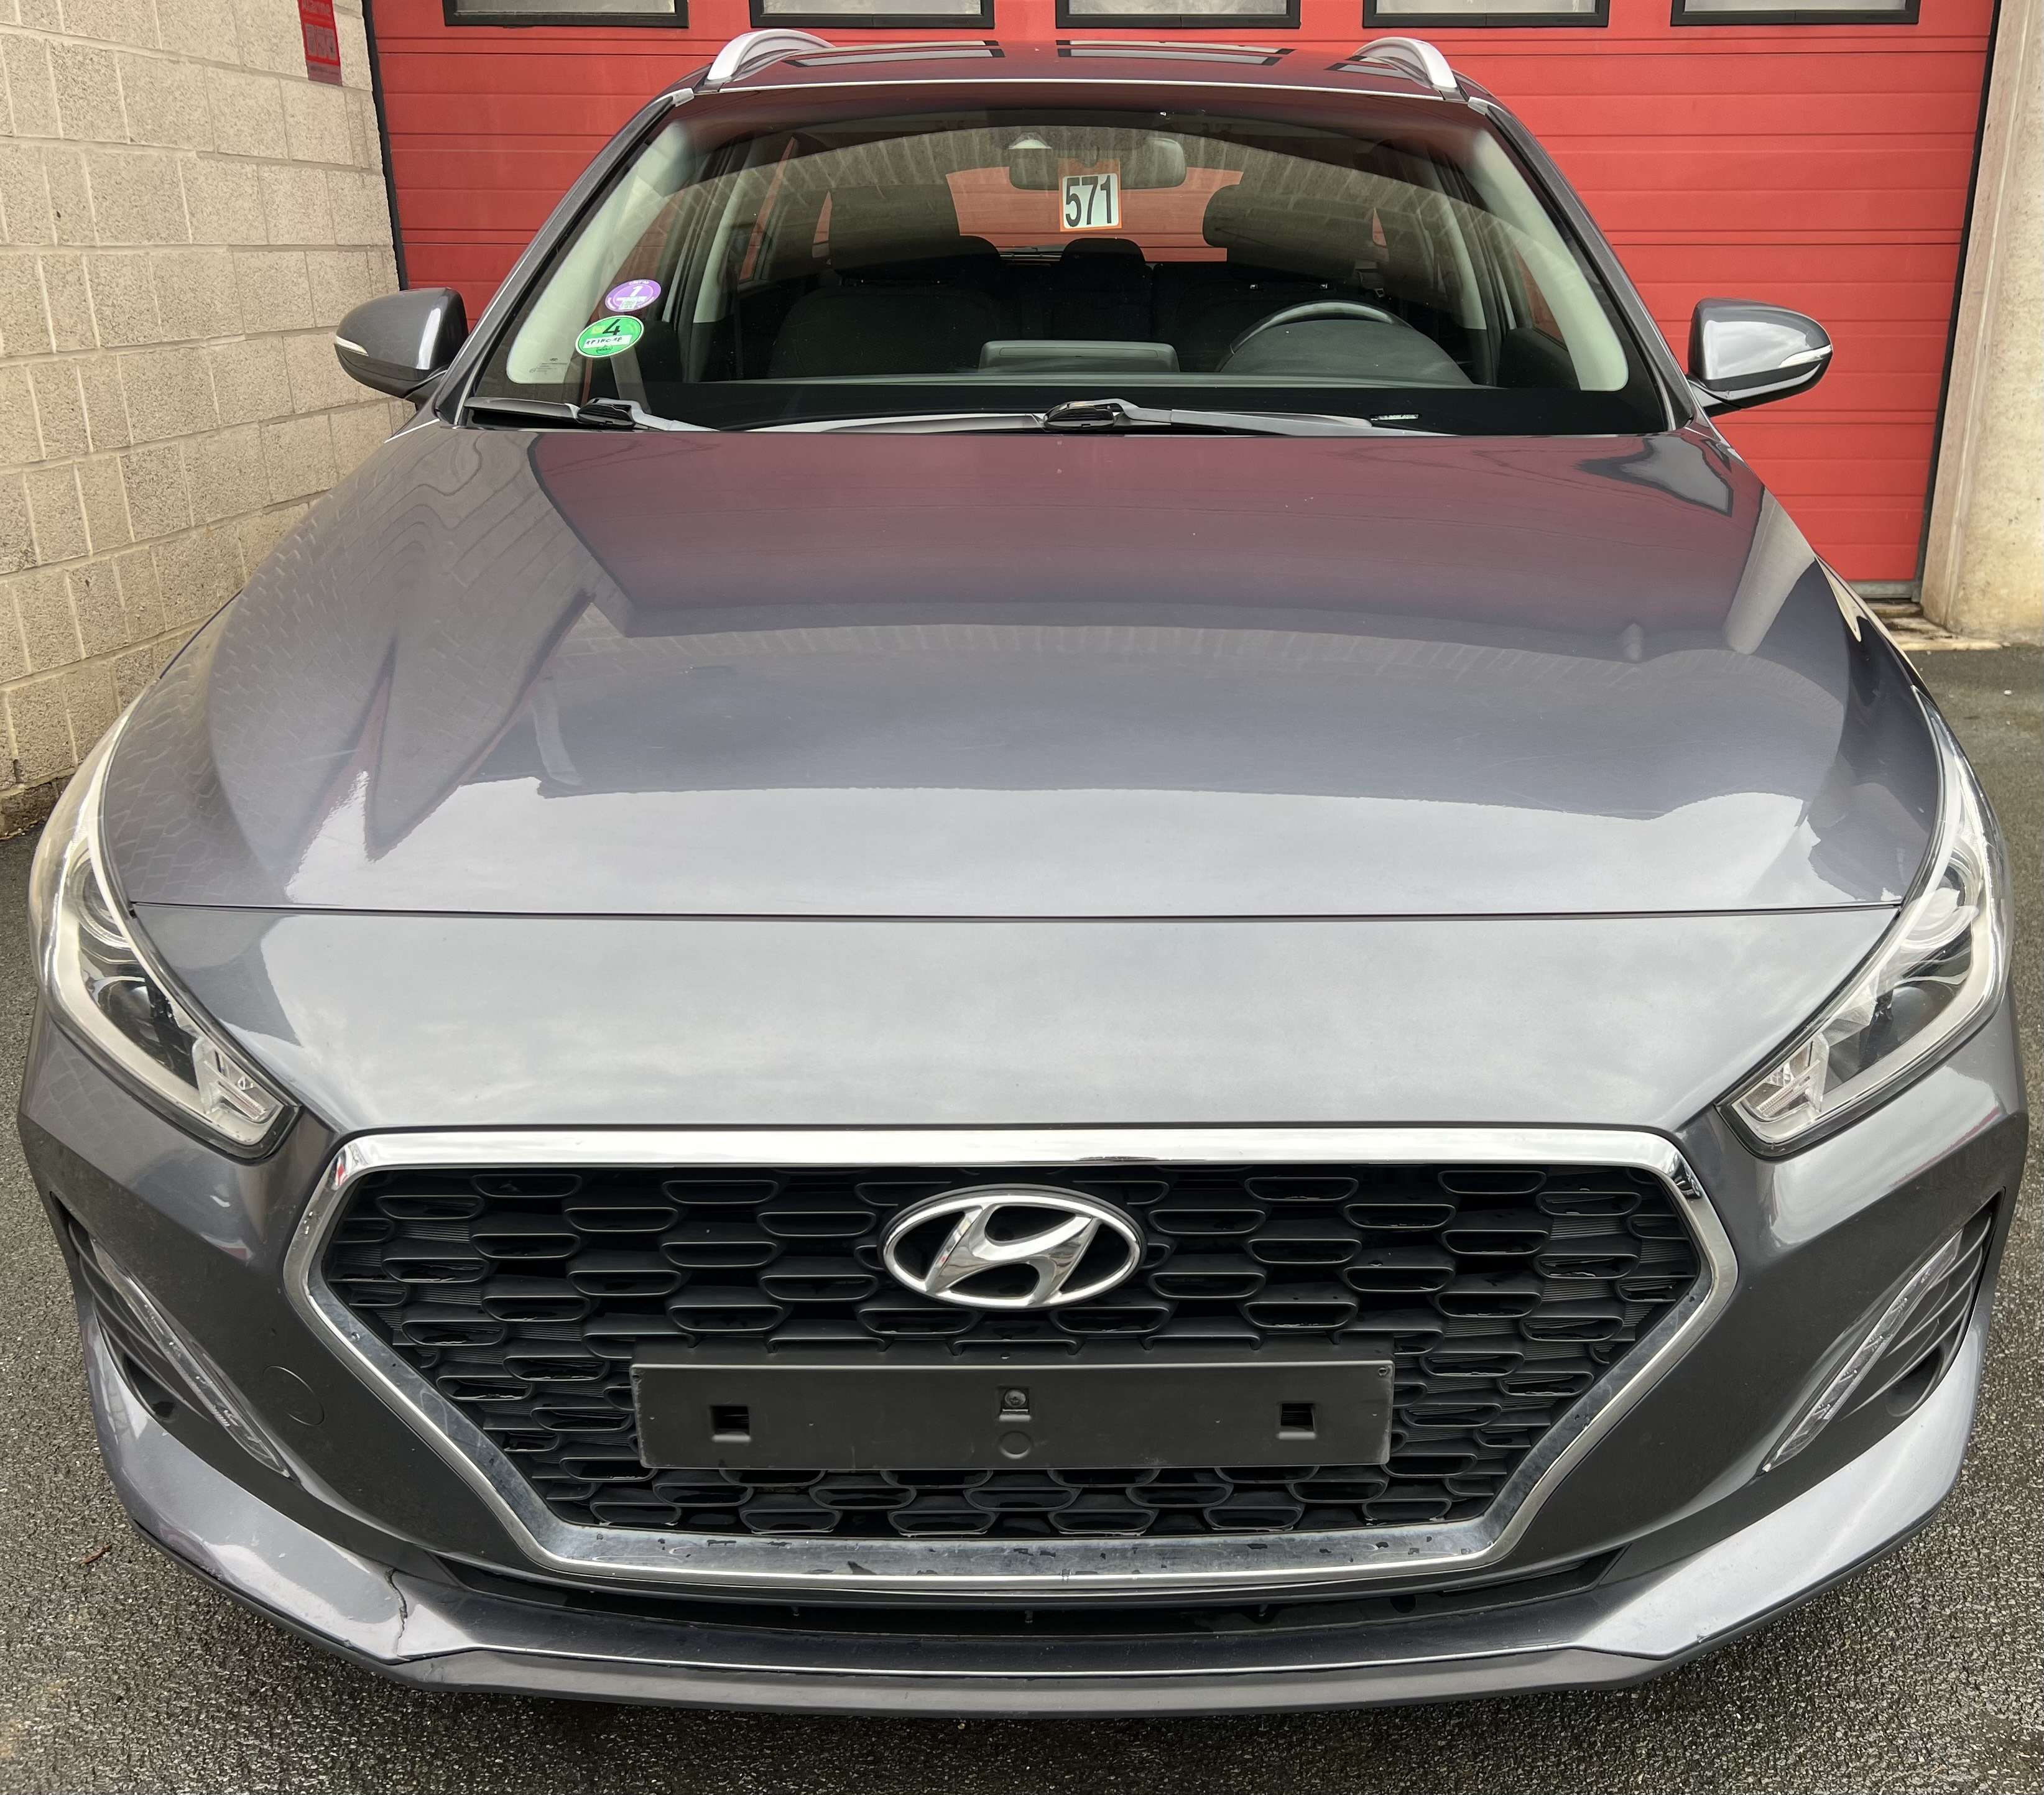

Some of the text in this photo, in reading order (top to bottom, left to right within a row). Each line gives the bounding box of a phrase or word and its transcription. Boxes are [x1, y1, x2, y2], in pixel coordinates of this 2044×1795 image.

[1065, 175, 1112, 228] 571
[629, 285, 644, 297] 1
[602, 318, 621, 336] 4
